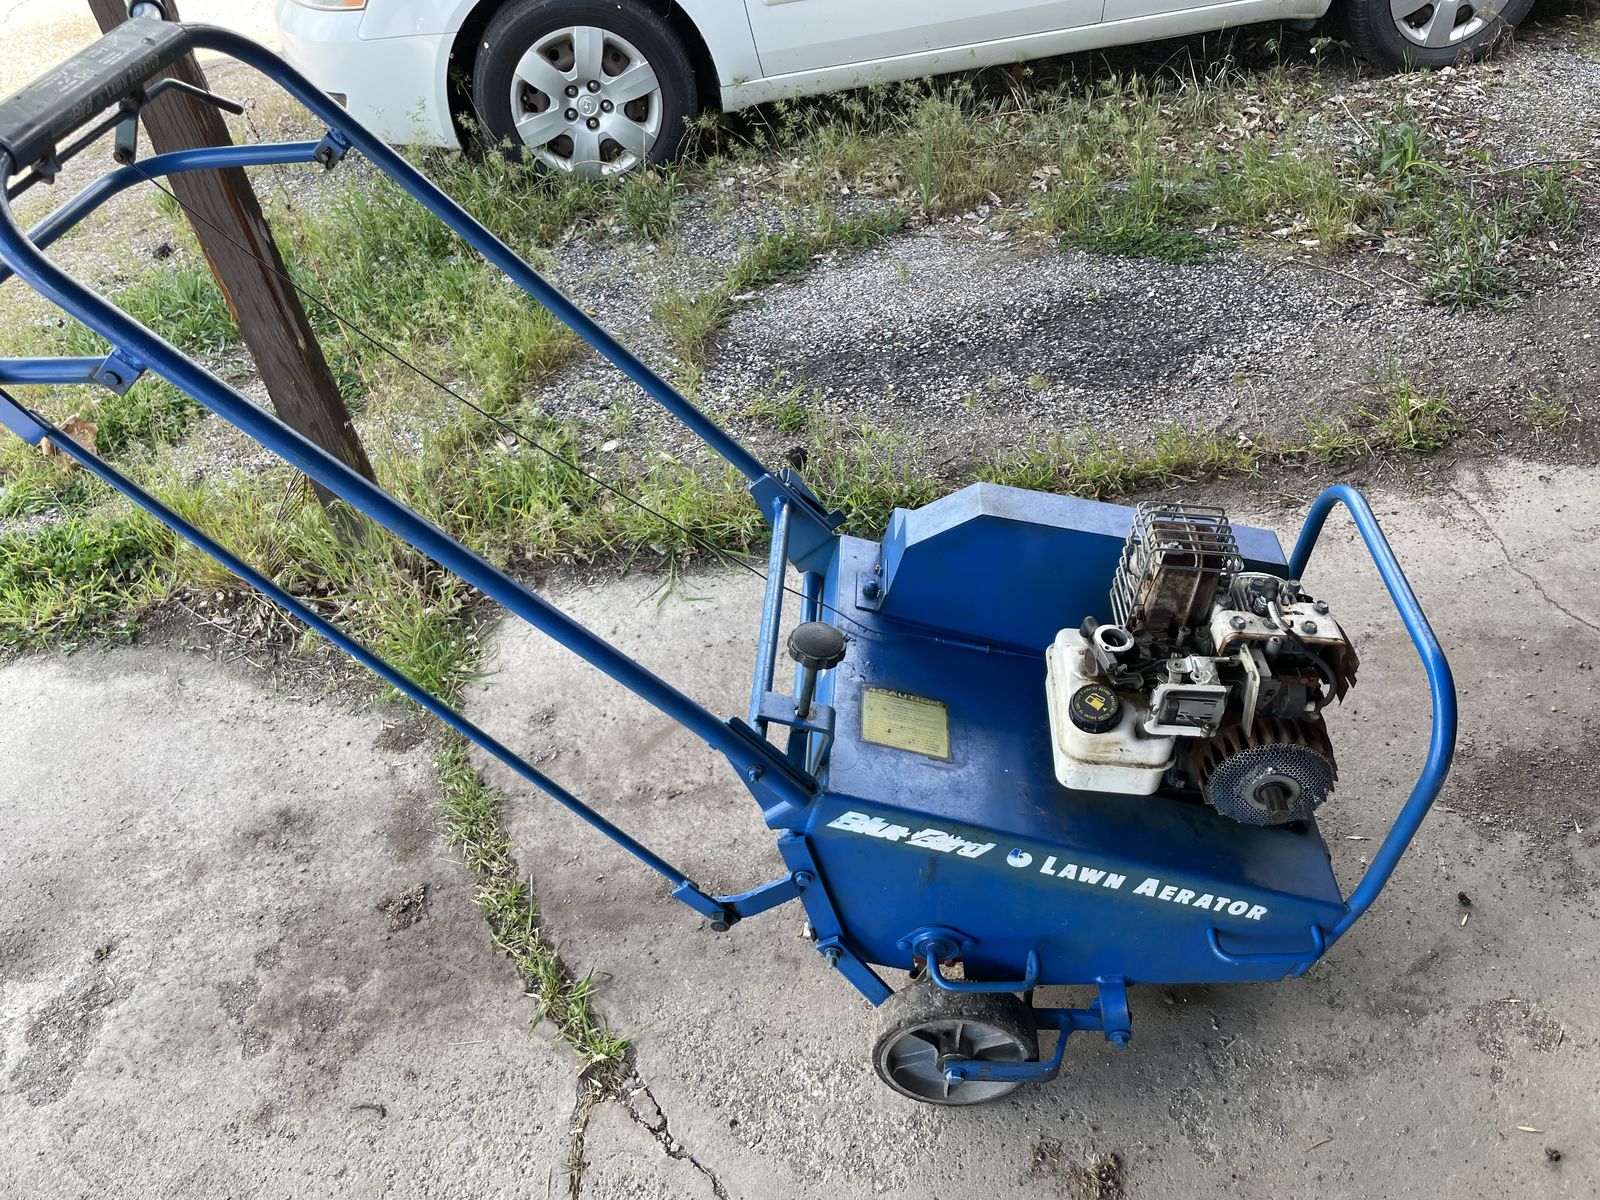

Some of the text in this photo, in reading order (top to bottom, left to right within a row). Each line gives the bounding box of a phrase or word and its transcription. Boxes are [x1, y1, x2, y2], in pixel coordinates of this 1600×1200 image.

[879, 688, 941, 704] CAUTION
[1039, 856, 1127, 889] LAWN
[1133, 878, 1268, 920] AERATOR
